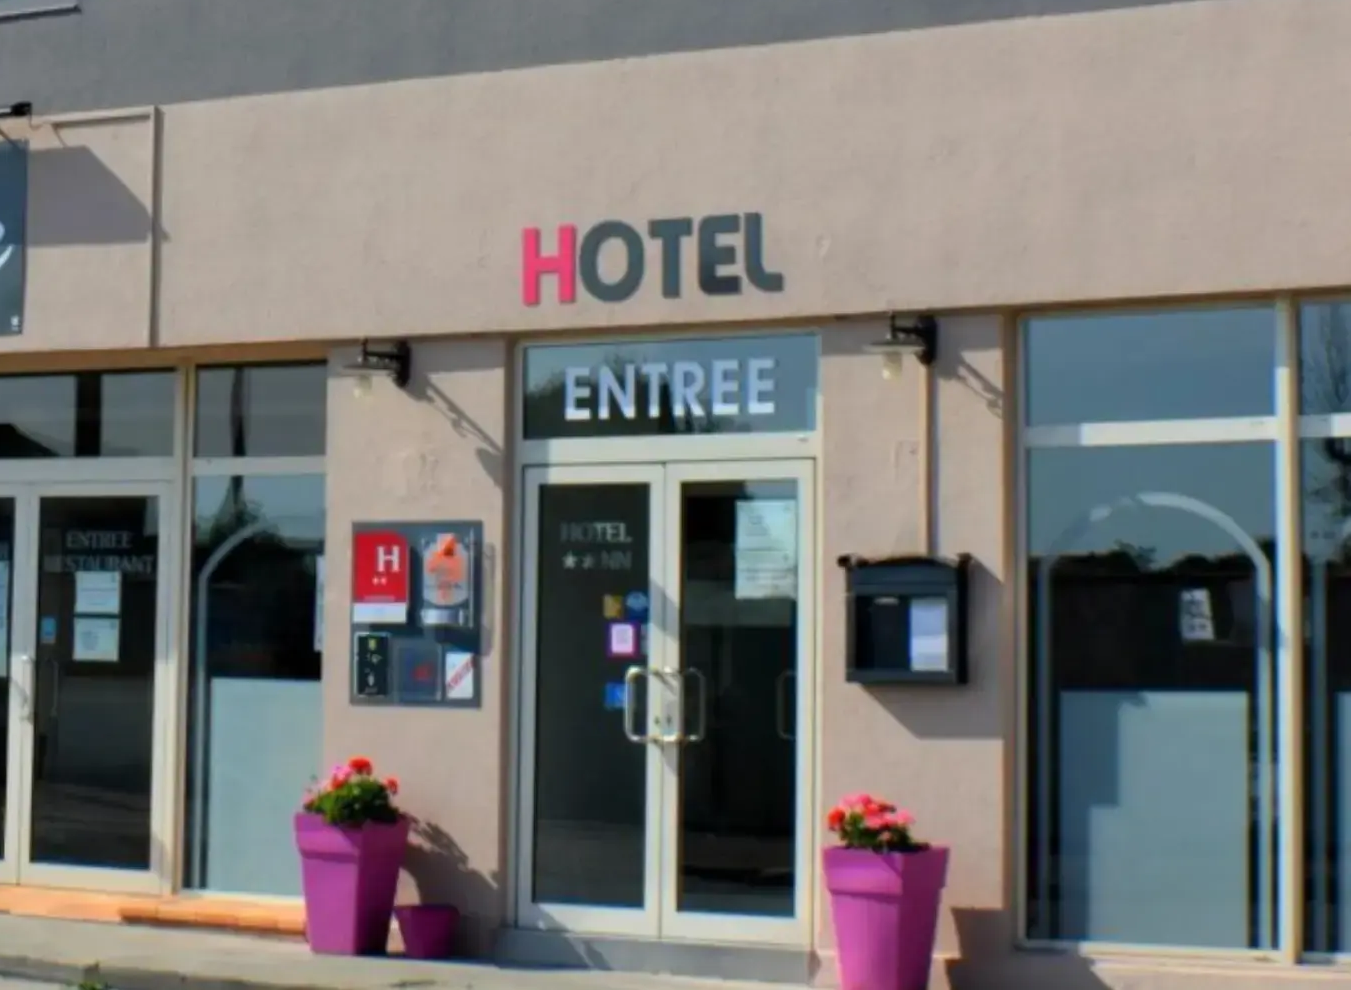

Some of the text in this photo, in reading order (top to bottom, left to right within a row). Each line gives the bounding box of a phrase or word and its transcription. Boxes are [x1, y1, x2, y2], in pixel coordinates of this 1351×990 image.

[521, 212, 785, 307] HOTEL
[564, 357, 776, 421] ENTREE
[559, 521, 634, 543] HOTEL
[44, 554, 155, 575] STAURANT
[376, 545, 401, 573] H
